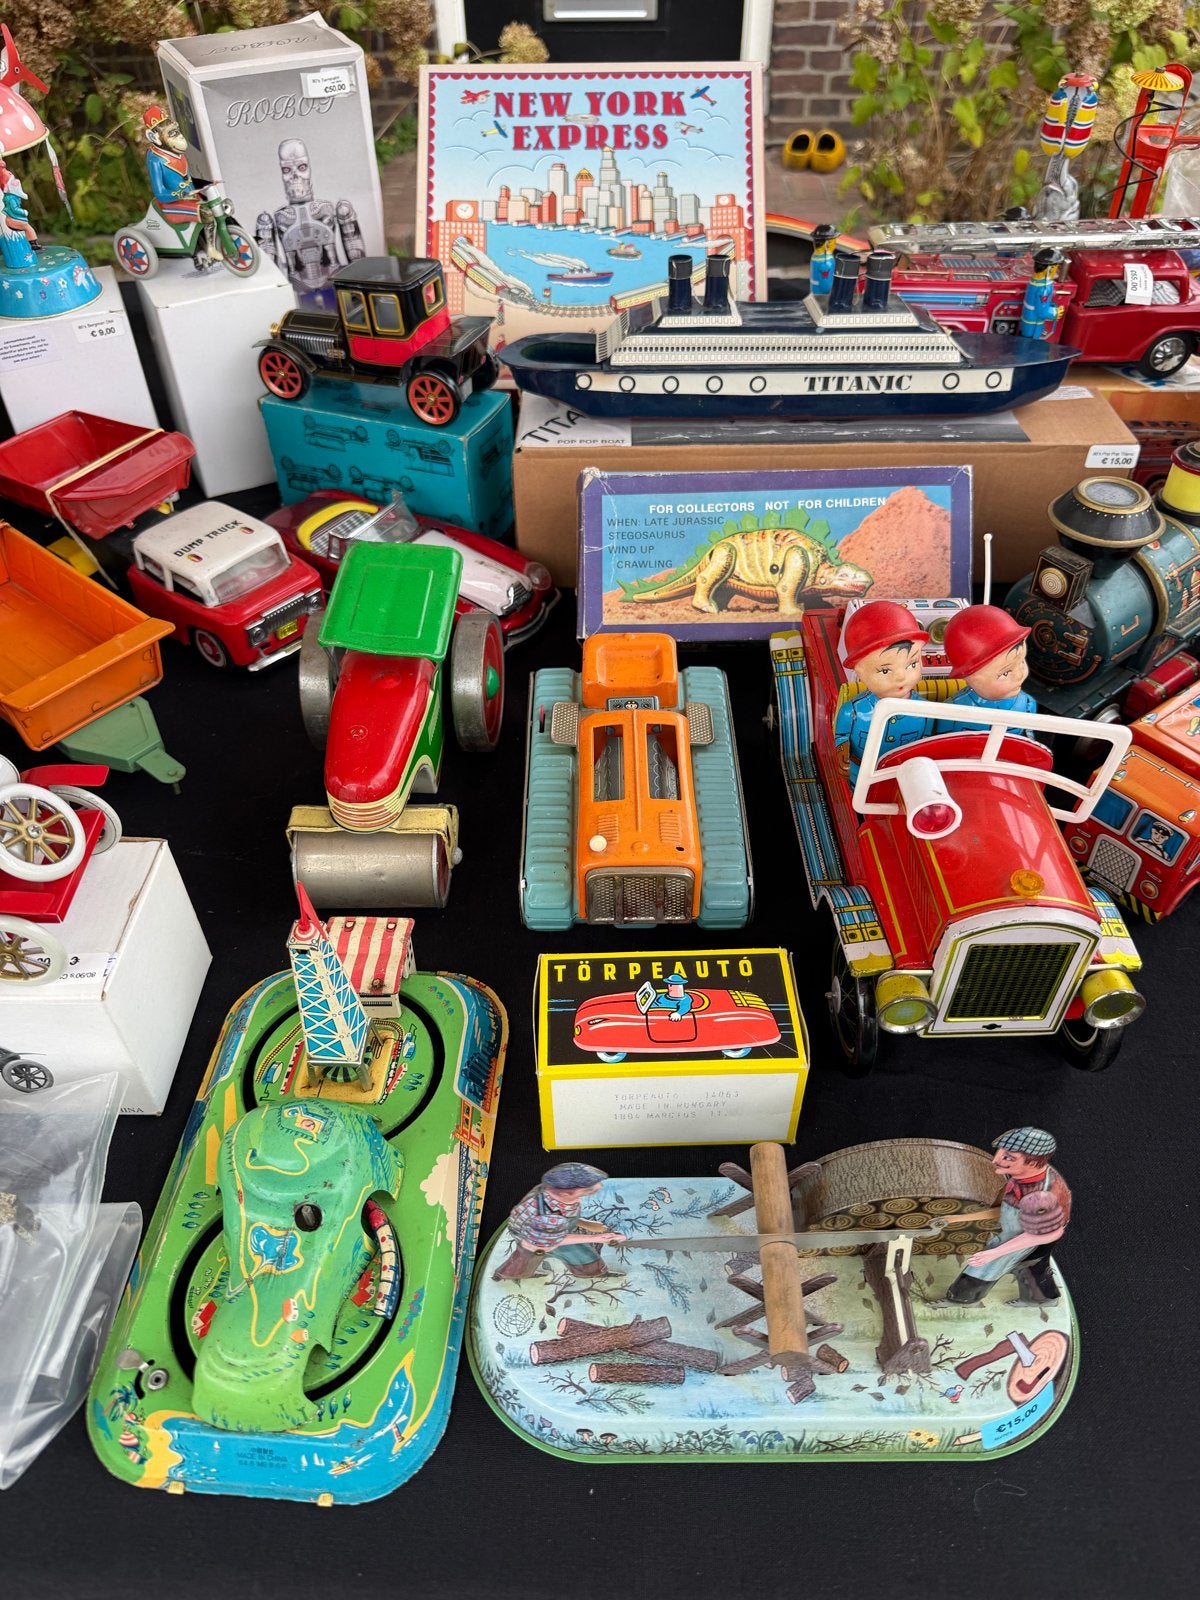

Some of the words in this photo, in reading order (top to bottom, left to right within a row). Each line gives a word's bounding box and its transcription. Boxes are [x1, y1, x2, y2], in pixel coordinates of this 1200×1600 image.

[493, 91, 573, 118] NEW
[585, 91, 687, 117] YORK
[512, 123, 669, 151] EXPRESS
[90, 329, 97, 338] €
[98, 327, 116, 336] 9,00
[804, 375, 913, 392] TITANIC
[521, 408, 588, 442] TITA
[1102, 457, 1108, 466] €
[1110, 457, 1133, 467] 15,00
[649, 504, 674, 514] FOR
[676, 501, 756, 514] COLLECTORS
[764, 500, 790, 511] NOT
[797, 499, 823, 510] FOR
[825, 497, 887, 509] CHILDREN
[644, 517, 670, 526] LATE
[672, 516, 726, 526] JURASSIC
[174, 539, 204, 557] DUMP
[206, 520, 243, 539] TRUCK
[608, 530, 687, 541] STEGOSAURUS
[608, 545, 637, 555] WIND
[640, 545, 656, 554] UP
[616, 559, 674, 569] CRAWLING
[553, 956, 754, 983] TÖRPEAUTÓ
[619, 1103, 648, 1111] MADE
[657, 1102, 670, 1110] IN
[676, 1101, 727, 1110] HUNGARY
